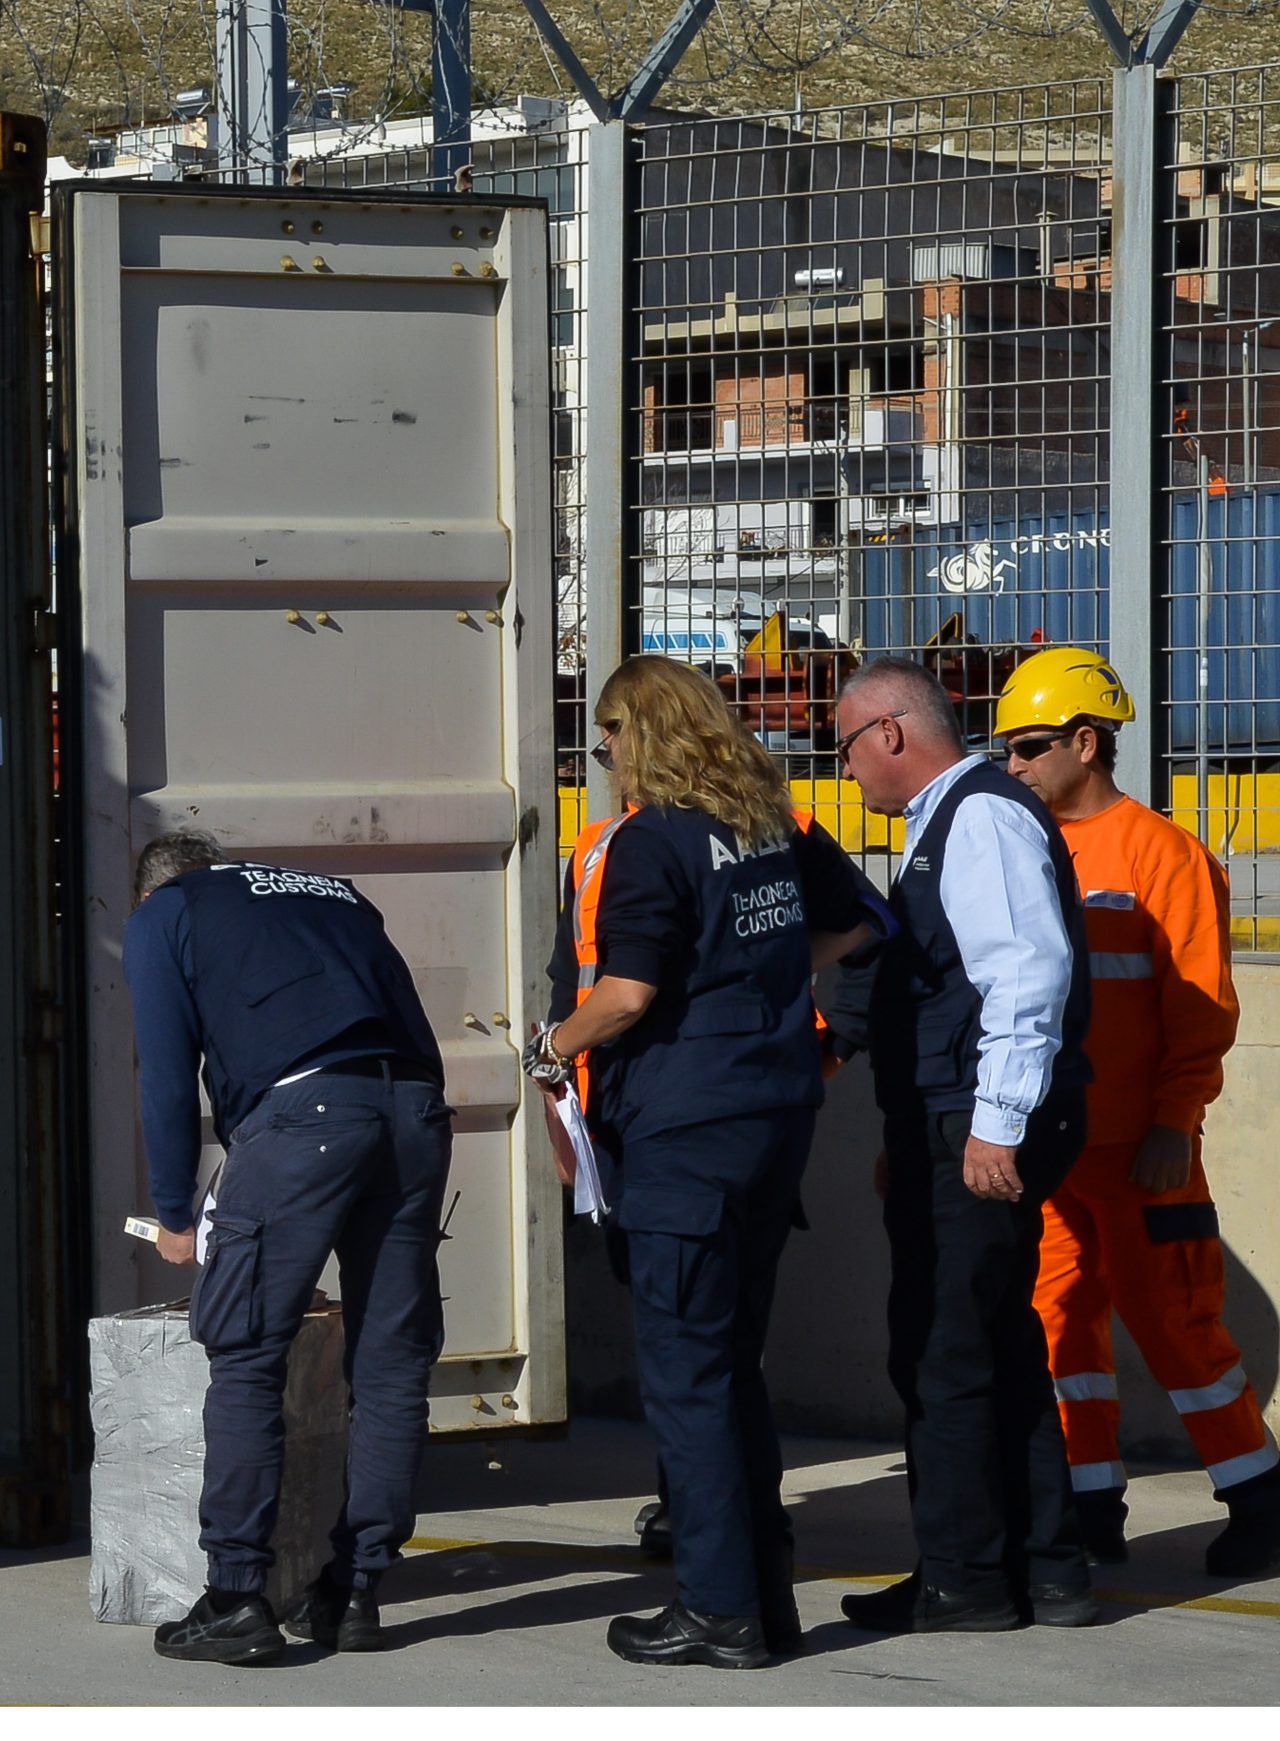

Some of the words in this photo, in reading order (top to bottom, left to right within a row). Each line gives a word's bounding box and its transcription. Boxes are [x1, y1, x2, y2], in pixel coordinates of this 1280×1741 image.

[240, 870, 350, 892] ΤΕΛΩΝΕΙΑ
[250, 882, 358, 904] CUSTOMS
[735, 902, 803, 937] CUSTOMS
